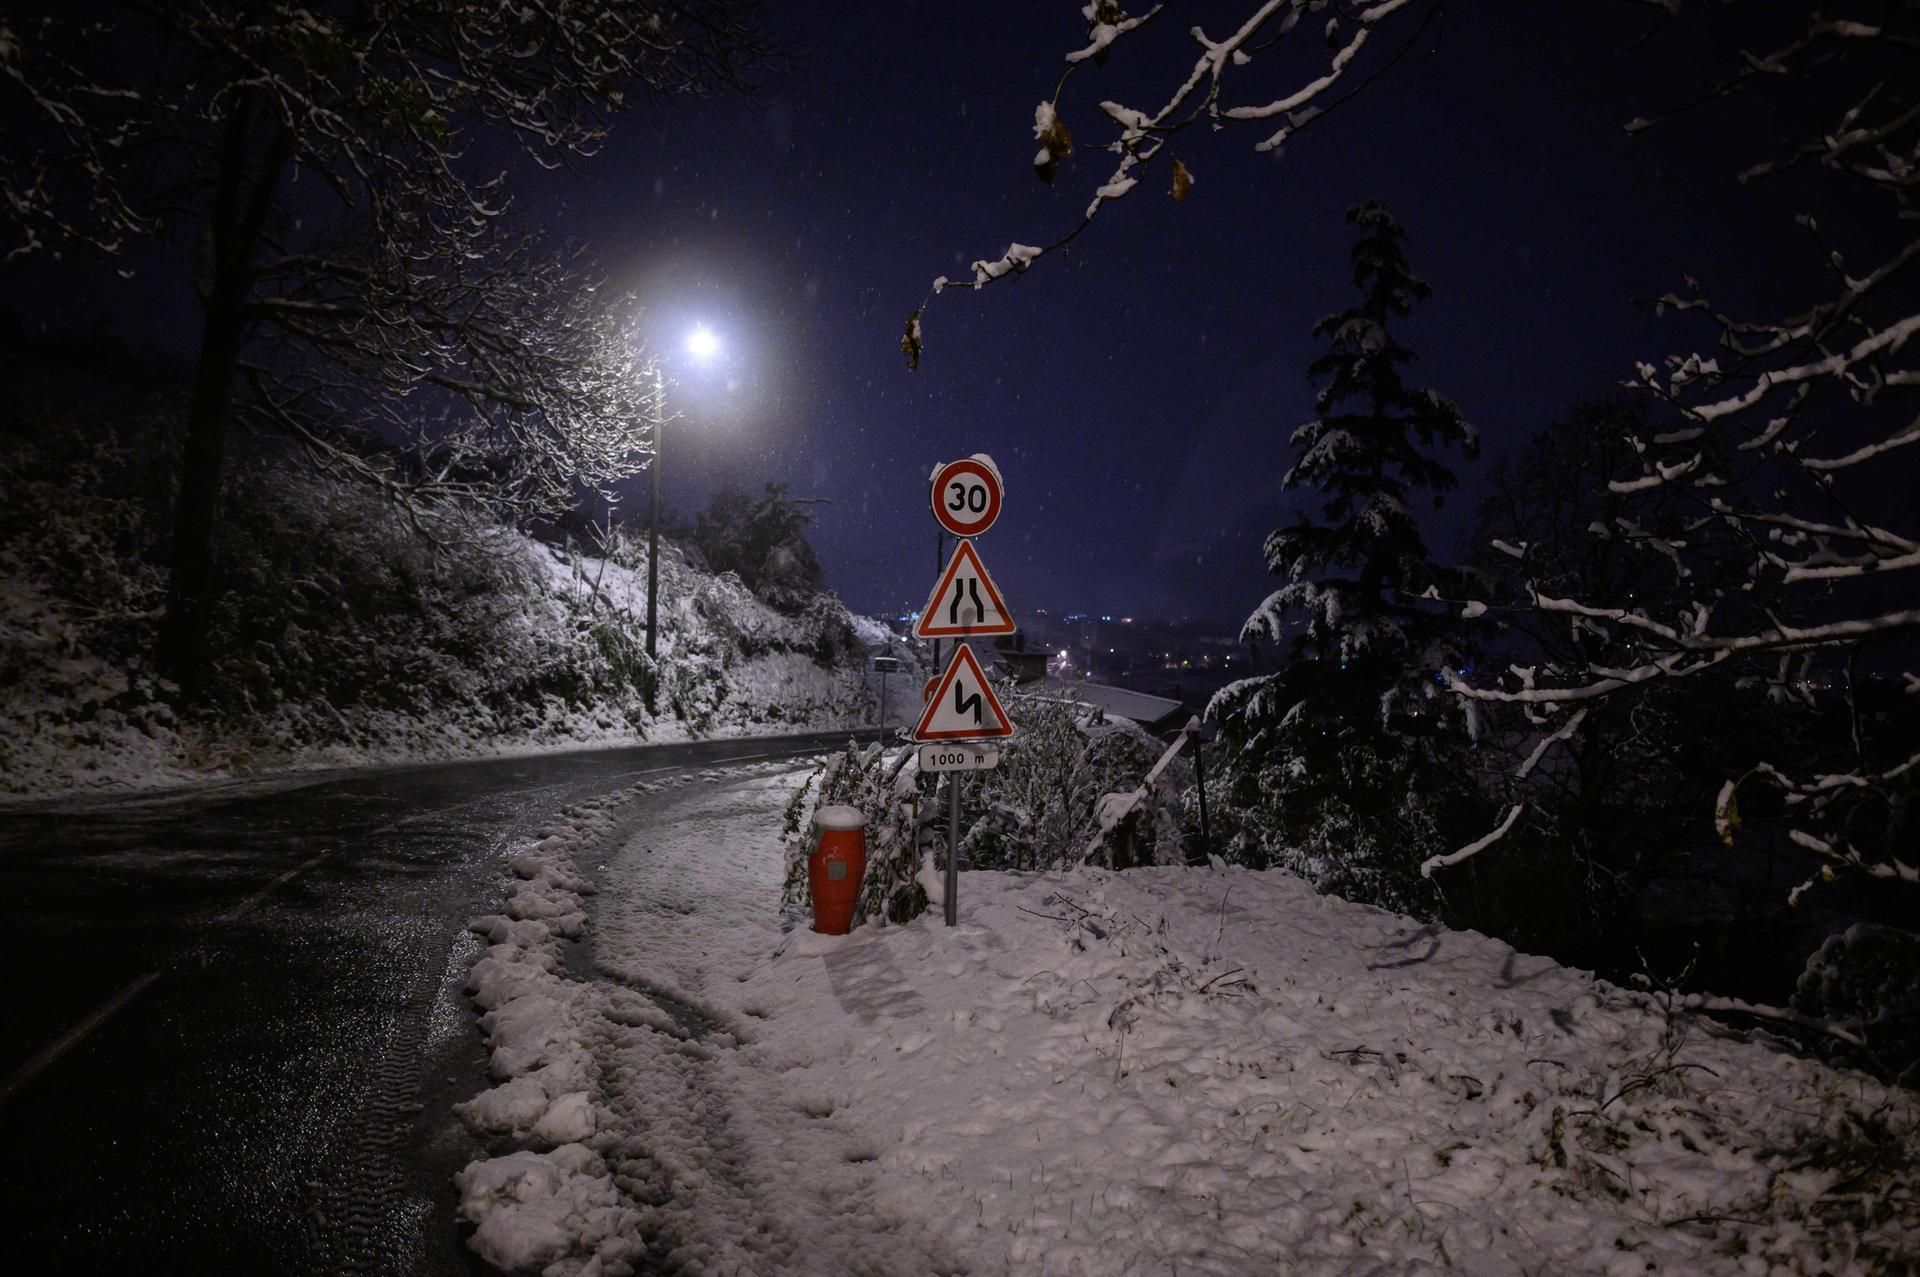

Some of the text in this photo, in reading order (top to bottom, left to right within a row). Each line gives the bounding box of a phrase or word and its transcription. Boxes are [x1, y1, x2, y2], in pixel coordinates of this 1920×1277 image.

[948, 482, 987, 513] 30
[930, 753, 985, 766] 1000 m
